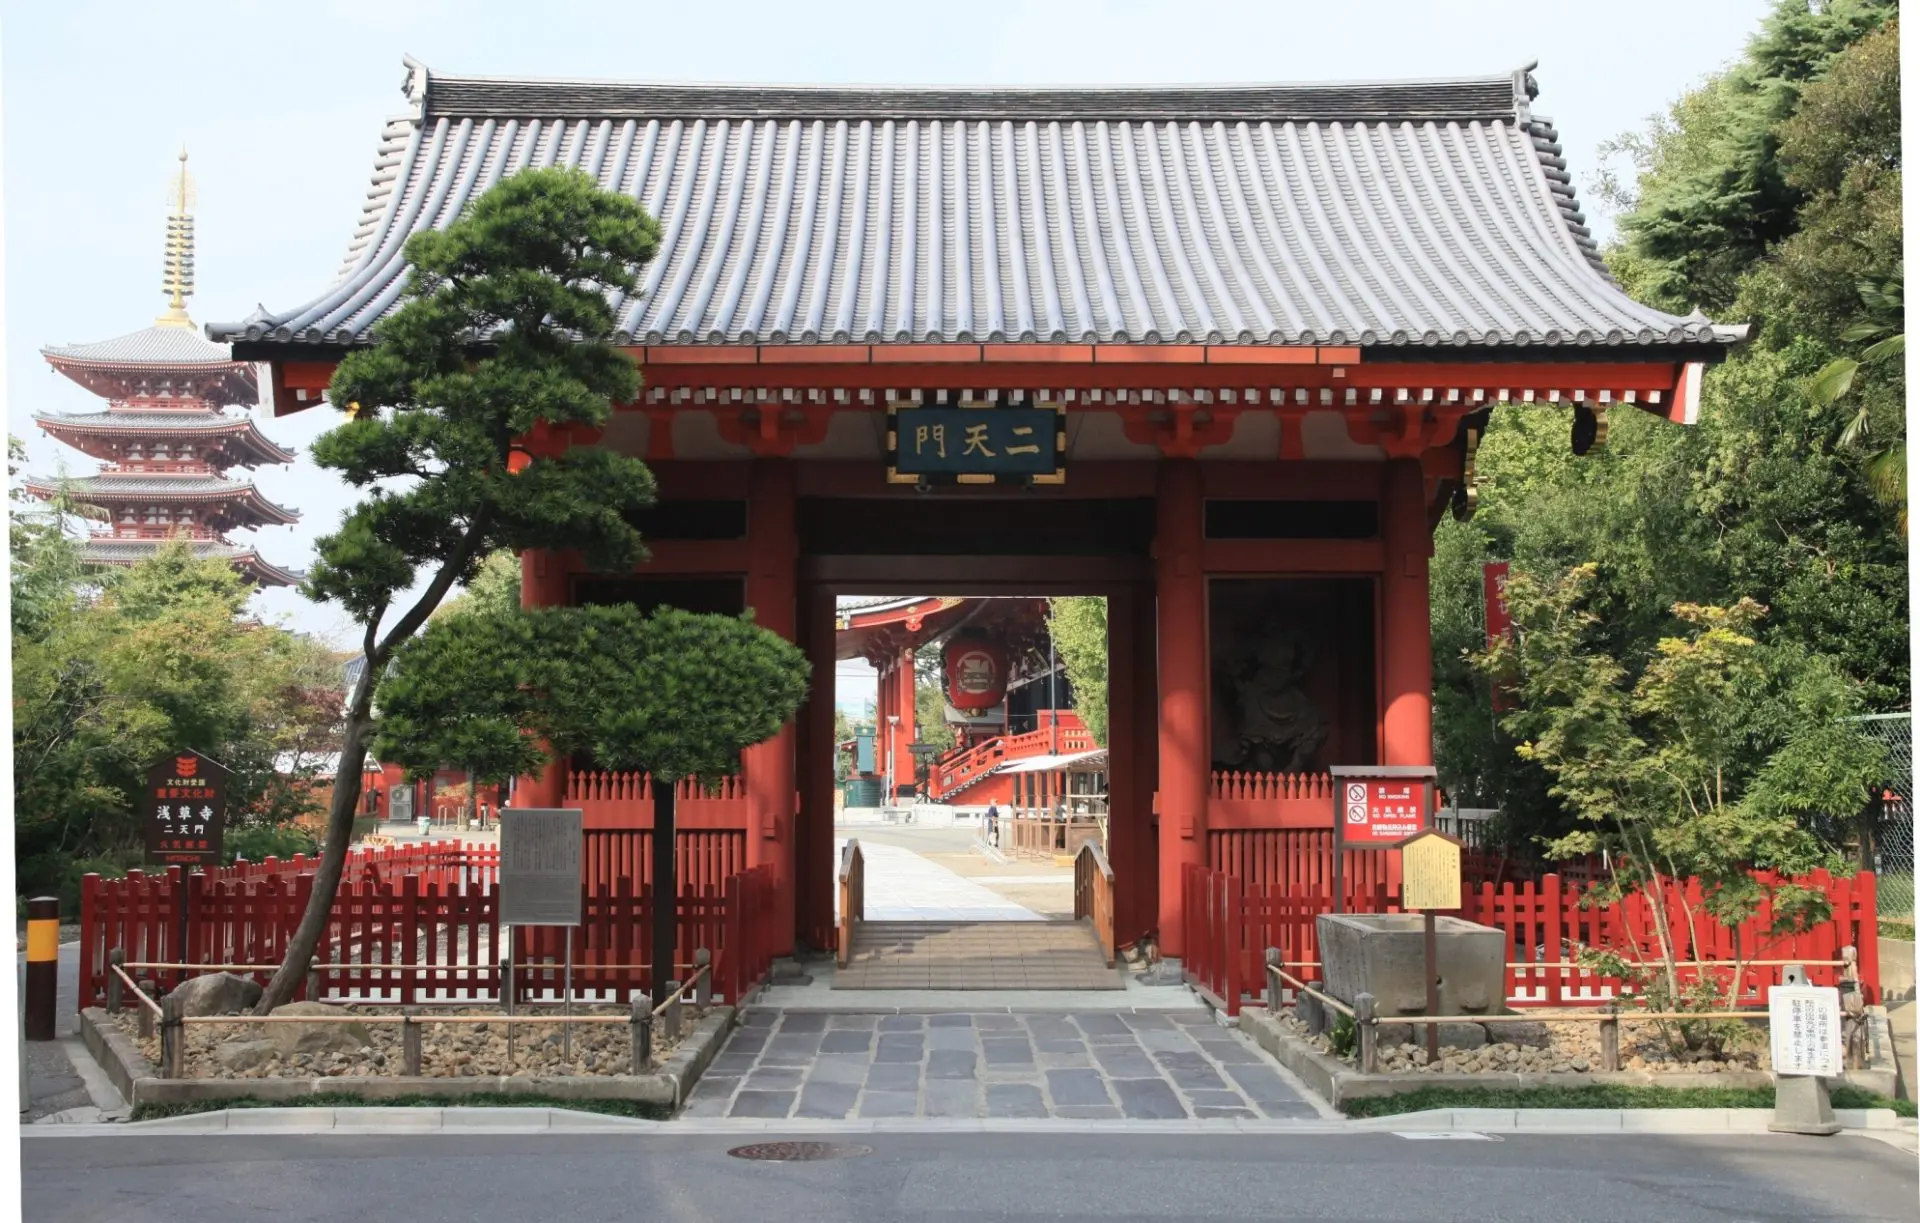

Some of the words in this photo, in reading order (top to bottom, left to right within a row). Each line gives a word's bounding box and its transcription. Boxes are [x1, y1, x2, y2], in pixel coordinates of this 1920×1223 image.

[915, 423, 1040, 458] 二天門
[157, 805, 213, 821] 浅草寺
[164, 824, 204, 834] 二天門
